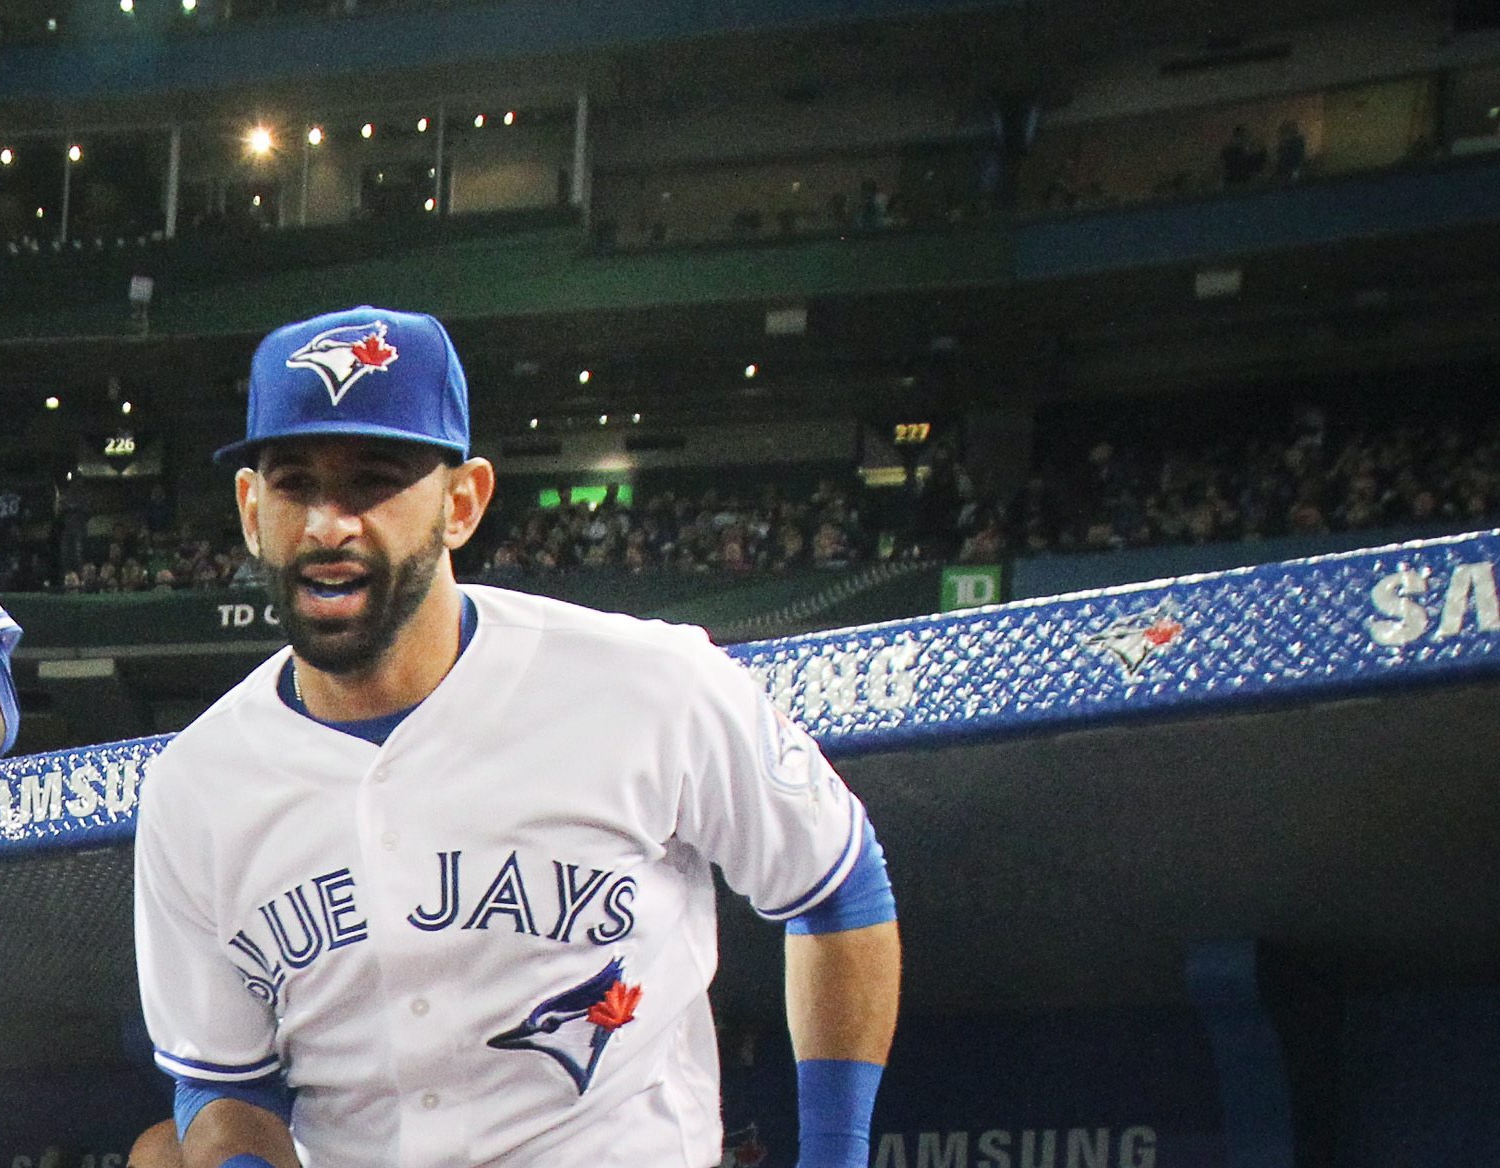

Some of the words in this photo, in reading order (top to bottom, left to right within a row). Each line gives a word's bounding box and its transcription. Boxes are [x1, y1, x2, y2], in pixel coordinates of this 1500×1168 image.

[949, 575, 994, 605] TD
[218, 604, 254, 627] TD
[407, 849, 637, 945] JAYS
